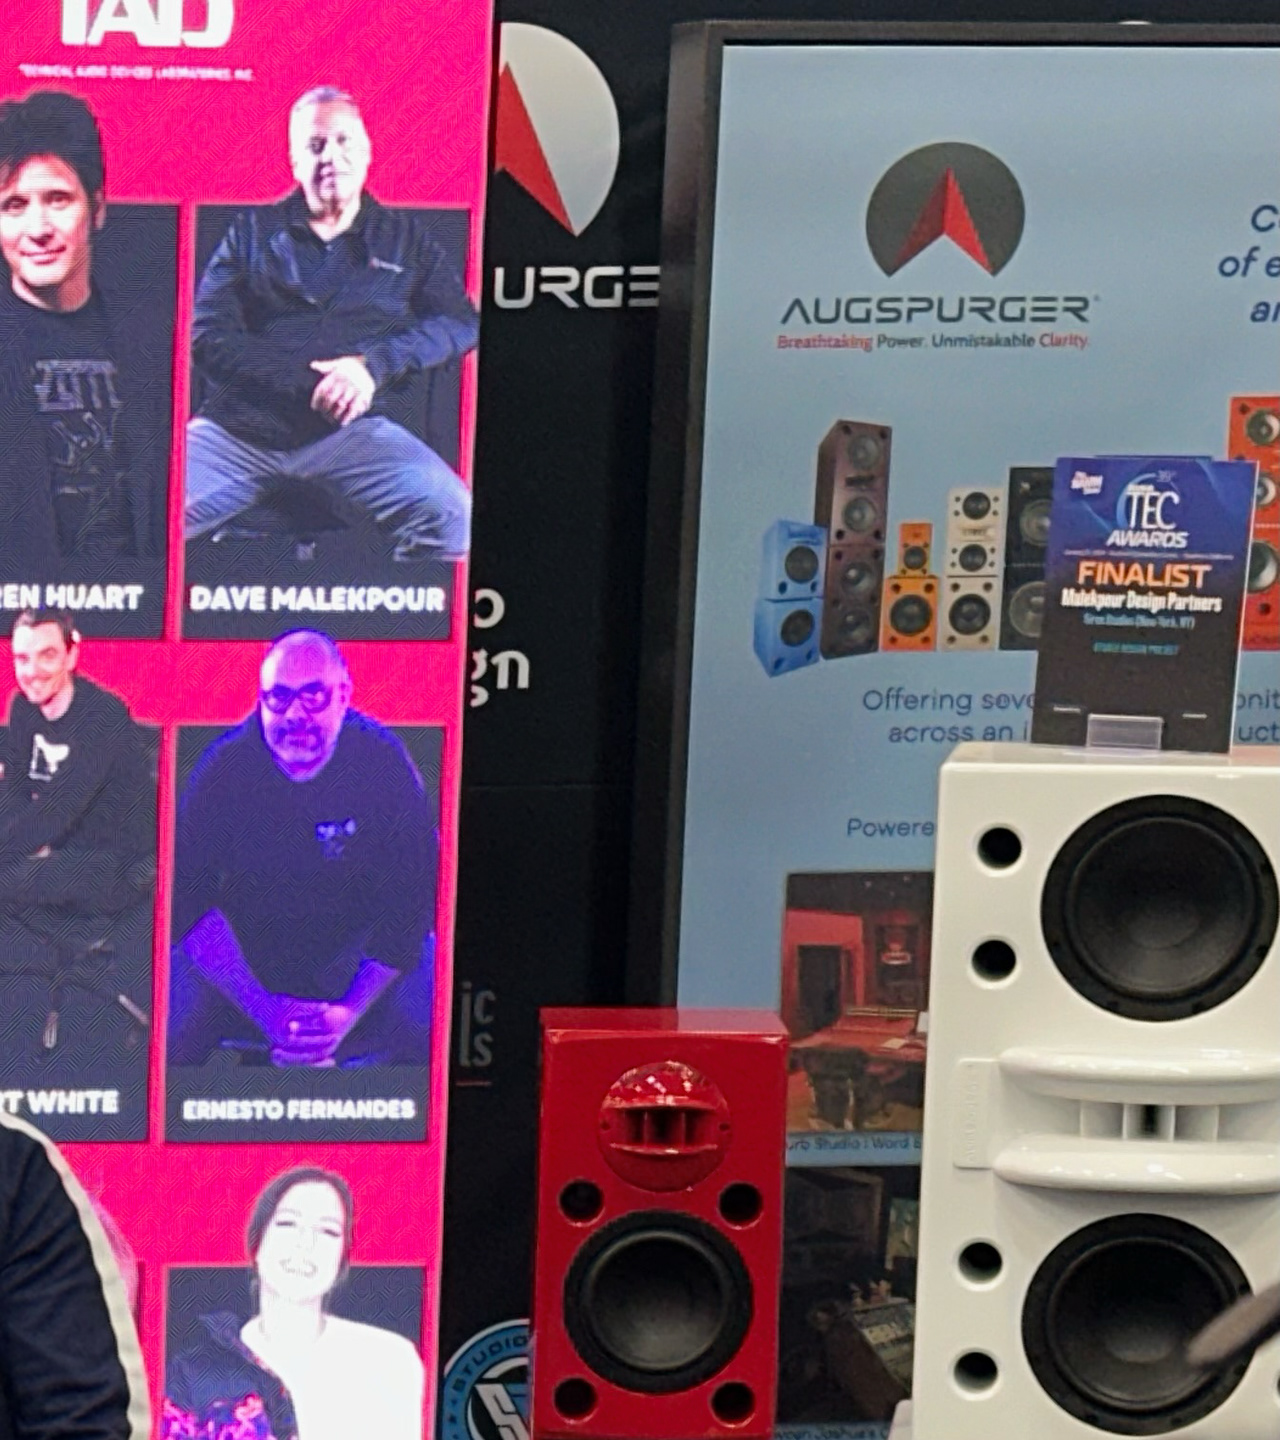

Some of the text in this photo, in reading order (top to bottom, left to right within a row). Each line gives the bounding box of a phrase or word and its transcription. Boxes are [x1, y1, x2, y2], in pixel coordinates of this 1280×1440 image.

[1218, 246, 1260, 278] of
[780, 296, 1090, 326] AUGSPURGER
[777, 334, 873, 352] Breathtaking
[931, 334, 1035, 350] Unmistakable
[1126, 491, 1181, 530] TEC
[1106, 529, 1190, 549] AWARDS
[1077, 560, 1213, 589] FINALIST
[45, 584, 144, 610] HUART
[190, 585, 267, 612] DAVE
[271, 585, 446, 612] MALEKPOUR
[1127, 590, 1167, 614] Design
[1168, 592, 1223, 613] Partners
[862, 688, 973, 716] Offering
[888, 722, 1014, 744] across an
[26, 1089, 119, 1114] WHITE
[182, 1098, 416, 1121] ERNESTO FERNANDES
